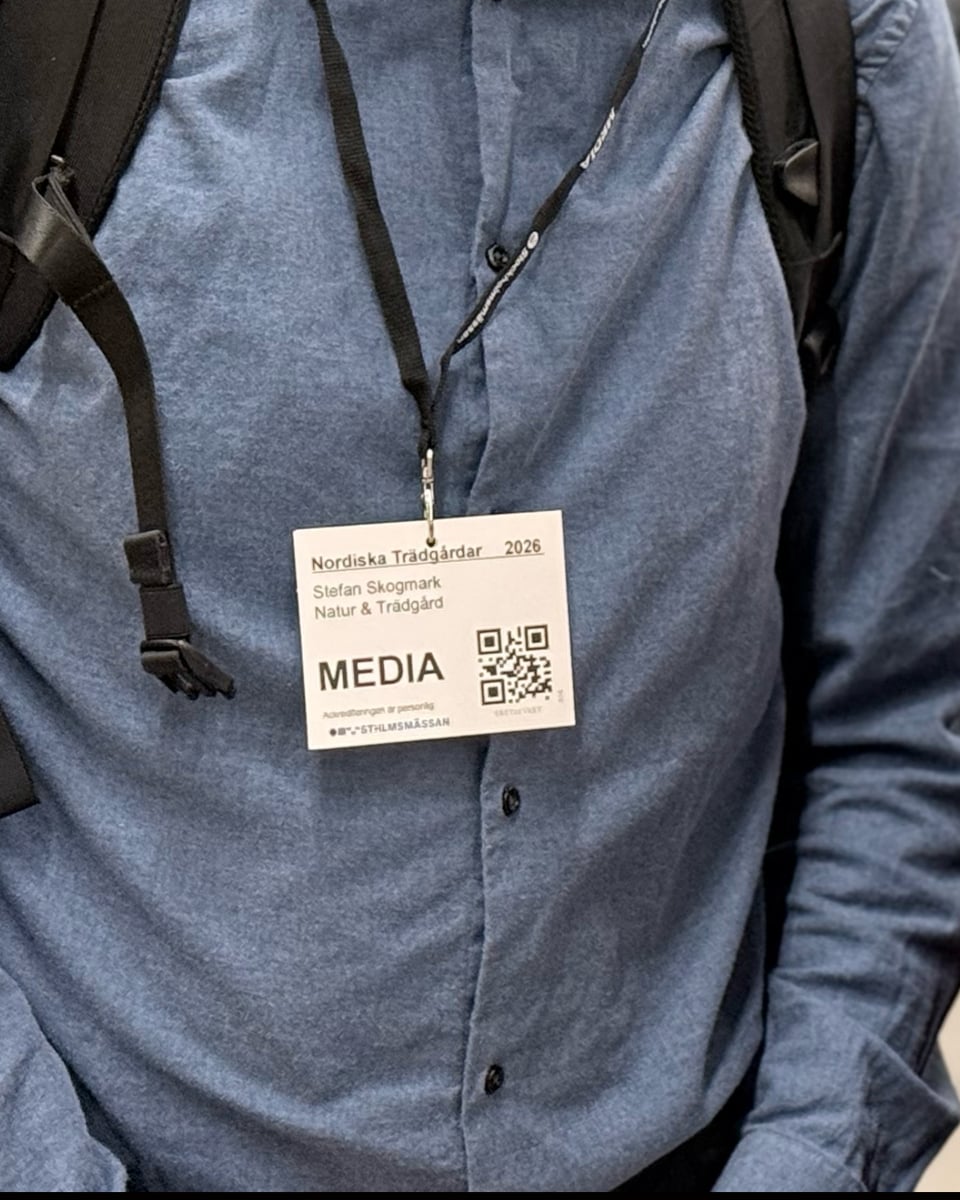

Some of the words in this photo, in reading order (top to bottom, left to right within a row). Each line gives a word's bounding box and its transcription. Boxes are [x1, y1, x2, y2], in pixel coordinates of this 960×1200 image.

[580, 106, 615, 169] MEDIA
[311, 552, 387, 571] Nordiska
[393, 545, 483, 565] Trädgårdar
[505, 538, 542, 555] 2026
[313, 582, 362, 599] Stefan
[366, 576, 442, 596] Skogmark
[314, 604, 357, 620] Natur
[361, 602, 372, 615] &
[376, 596, 444, 616] Trädgård
[318, 652, 445, 691] MEDIA
